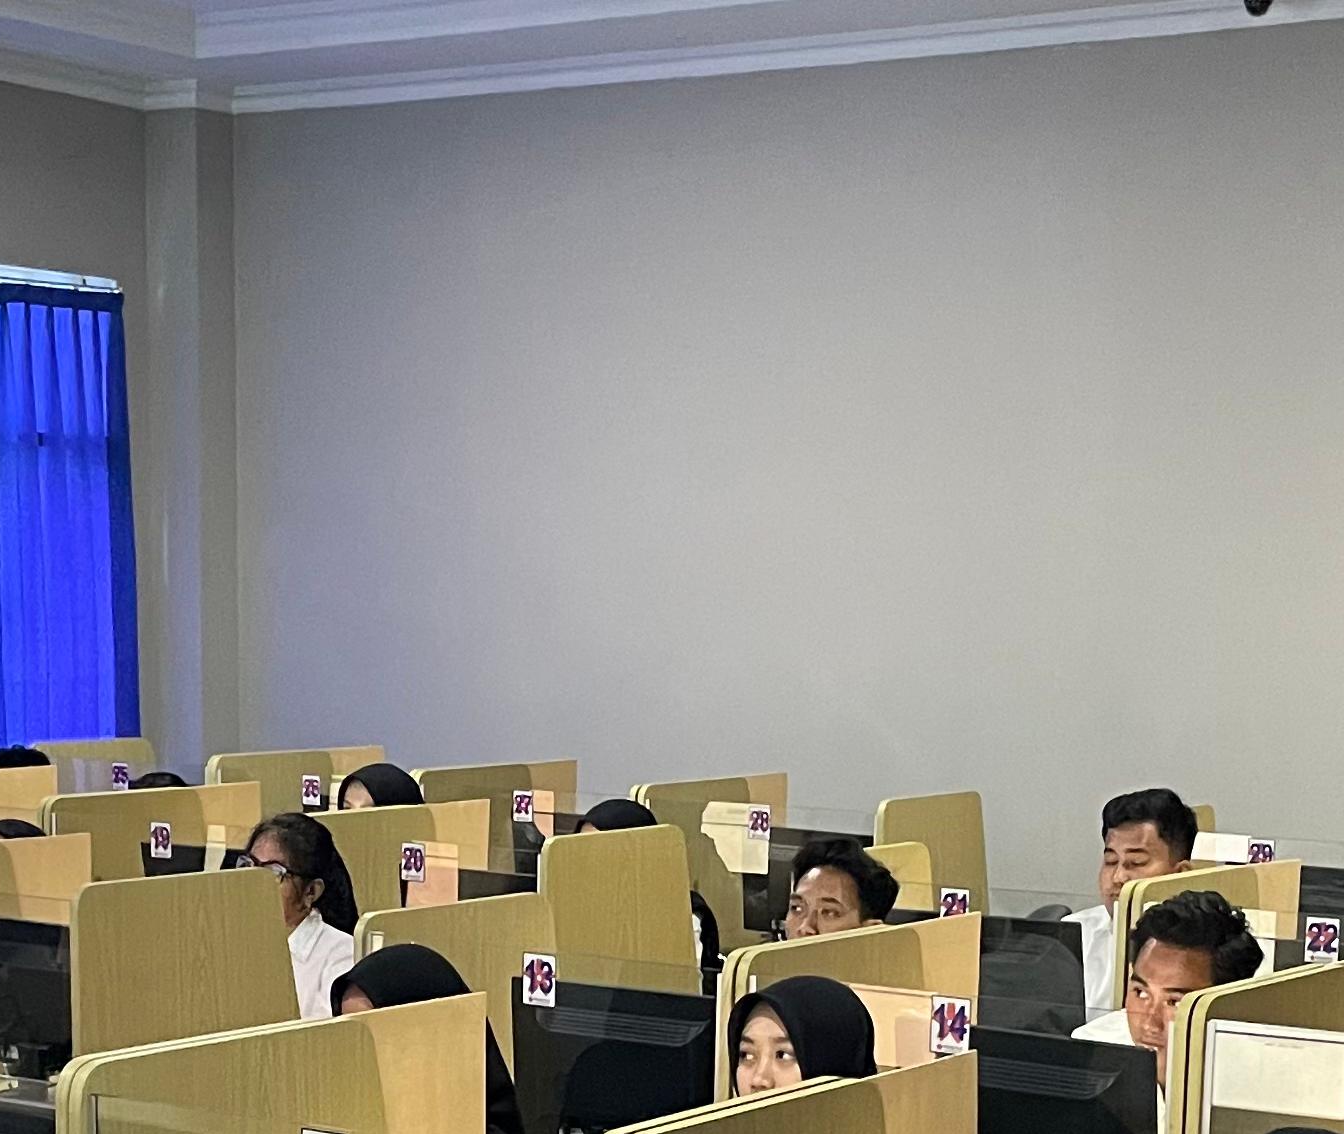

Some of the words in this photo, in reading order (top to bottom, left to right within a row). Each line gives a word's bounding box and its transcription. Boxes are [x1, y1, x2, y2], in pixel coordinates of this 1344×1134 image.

[113, 765, 128, 784] 25
[304, 779, 319, 797] 26
[515, 795, 531, 814] 27
[751, 810, 769, 832] 28
[152, 826, 170, 849] 19
[403, 847, 423, 872] 20
[1250, 843, 1272, 863] 29
[943, 893, 966, 917] 21
[1308, 923, 1337, 952] 22
[526, 959, 553, 993] 13
[934, 1004, 967, 1041] 14
